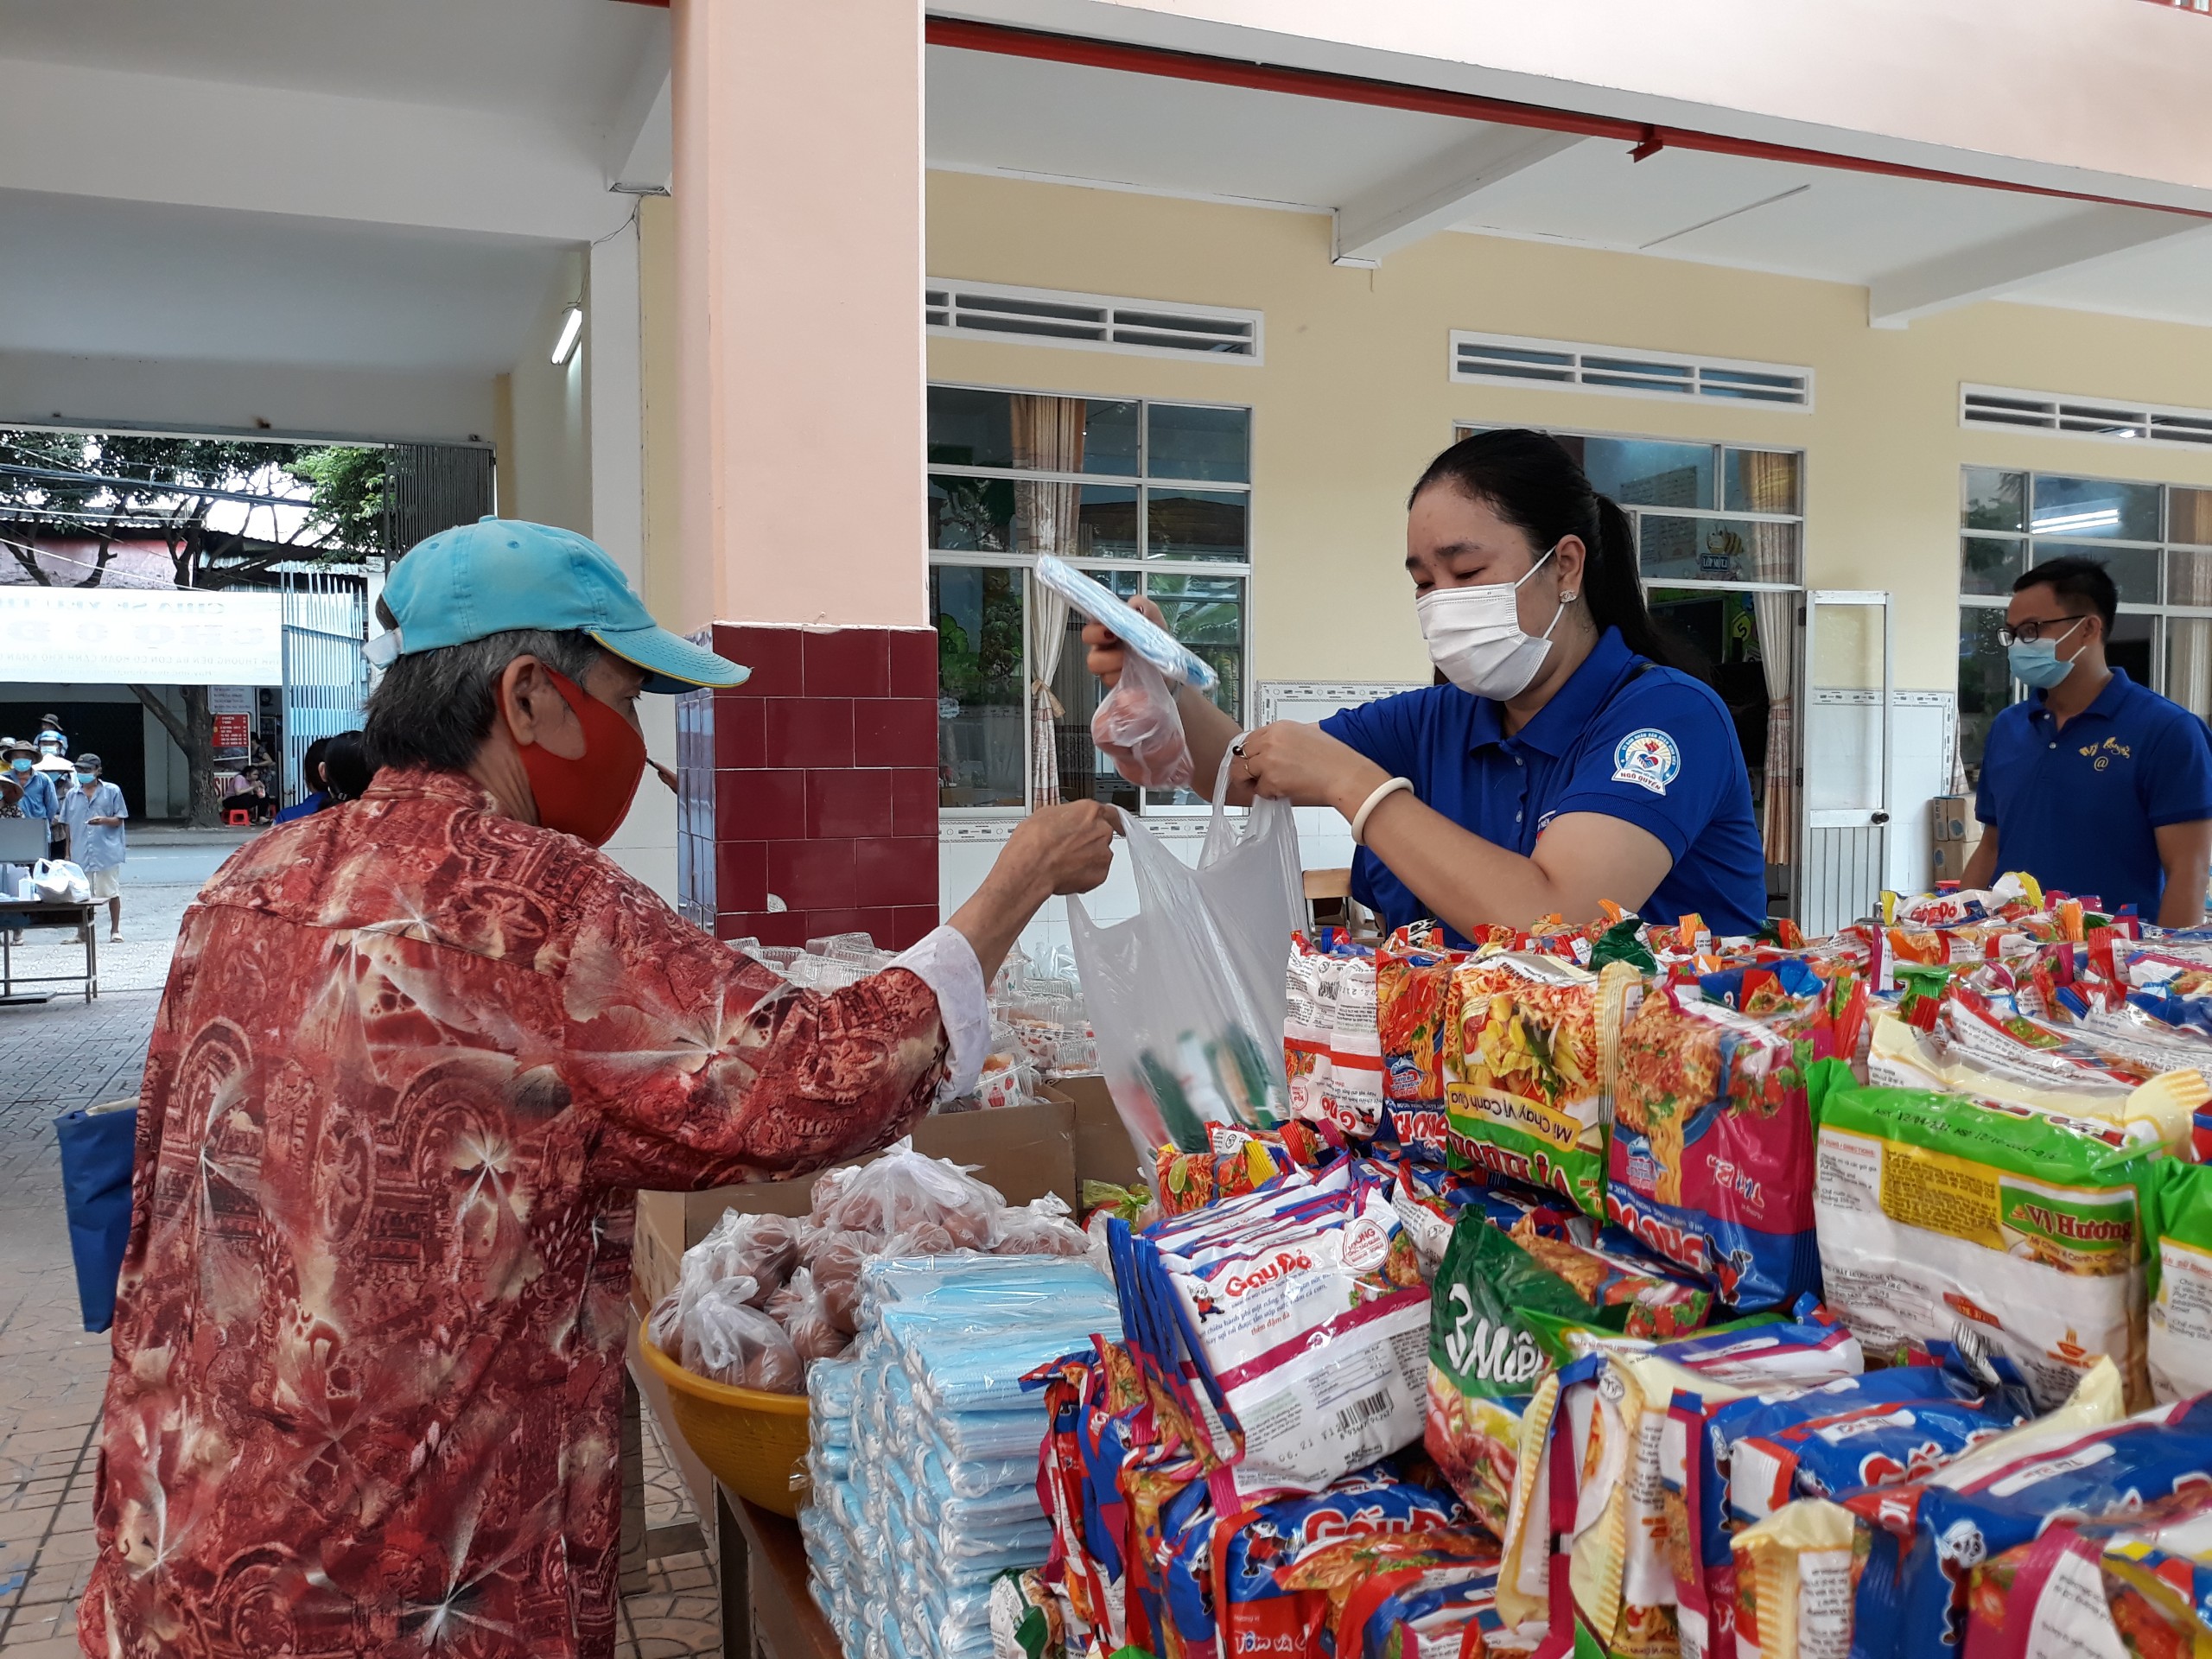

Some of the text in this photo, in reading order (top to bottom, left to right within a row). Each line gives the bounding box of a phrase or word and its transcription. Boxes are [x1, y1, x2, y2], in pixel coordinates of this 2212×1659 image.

[1738, 623, 1748, 638] 5
[1470, 1093, 1503, 1116] Canh
[1519, 1104, 1551, 1133] Chay
[2025, 1203, 2133, 1243] Vị Hương
[1274, 1249, 1313, 1275] Đỏ
[1224, 1315, 1241, 1328] hành
[1250, 1311, 1292, 1337] thêm đậm đà
[1445, 1282, 1474, 1370] 3
